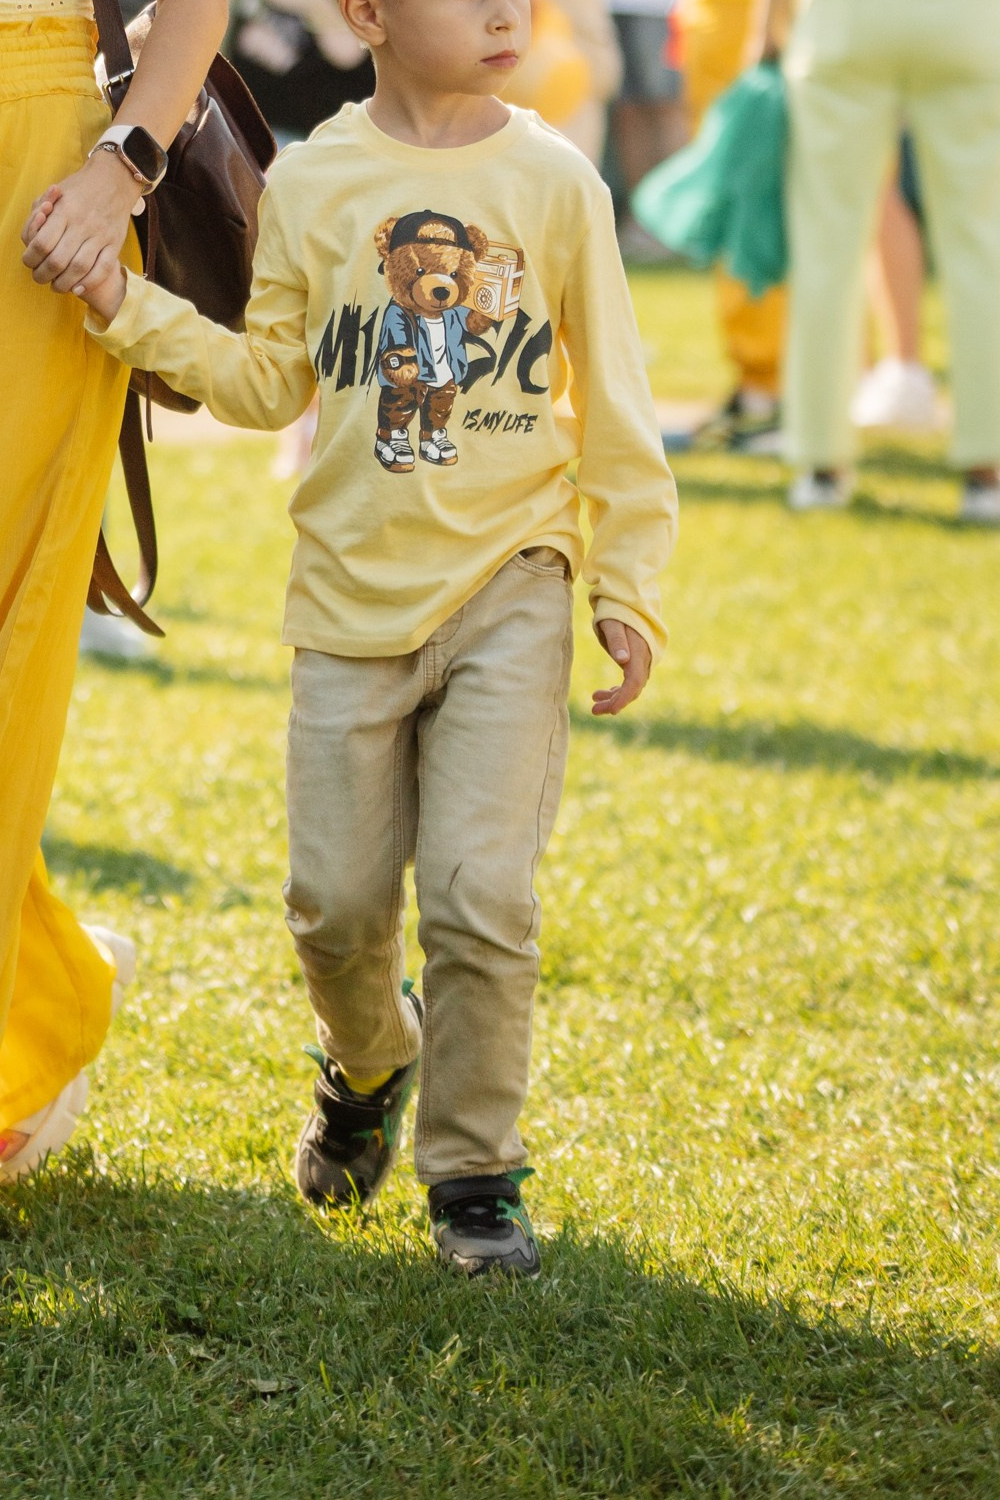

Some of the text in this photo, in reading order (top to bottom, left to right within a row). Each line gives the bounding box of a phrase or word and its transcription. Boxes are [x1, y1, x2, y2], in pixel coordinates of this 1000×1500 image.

[461, 408, 539, 436] IS MY LIFE
